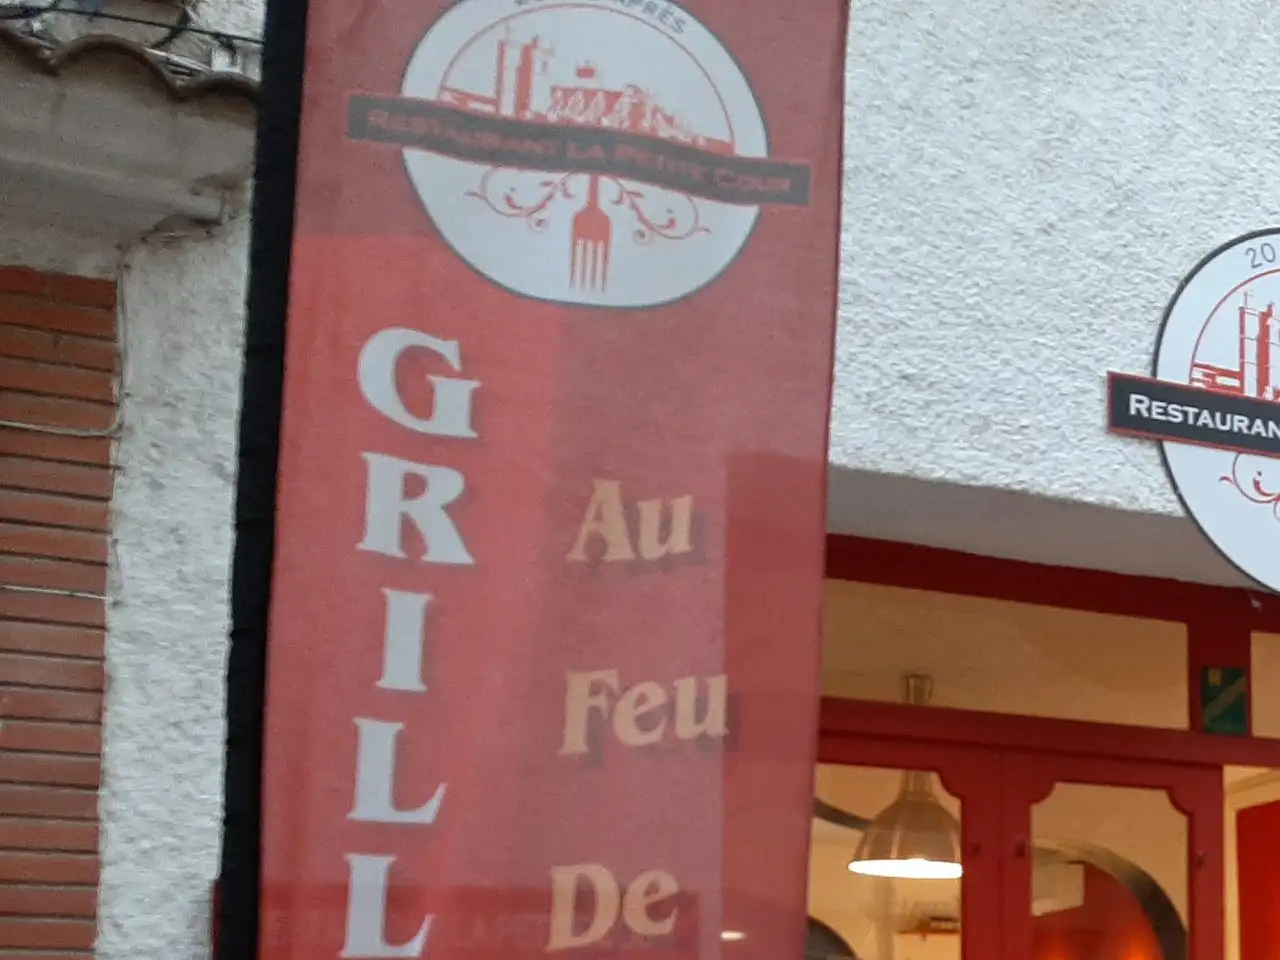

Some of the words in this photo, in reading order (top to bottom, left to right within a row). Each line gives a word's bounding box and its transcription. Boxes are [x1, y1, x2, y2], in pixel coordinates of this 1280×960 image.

[1245, 242, 1277, 269] 20
[564, 478, 695, 564] Au
[558, 668, 730, 757] Feu
[545, 862, 680, 953] De
